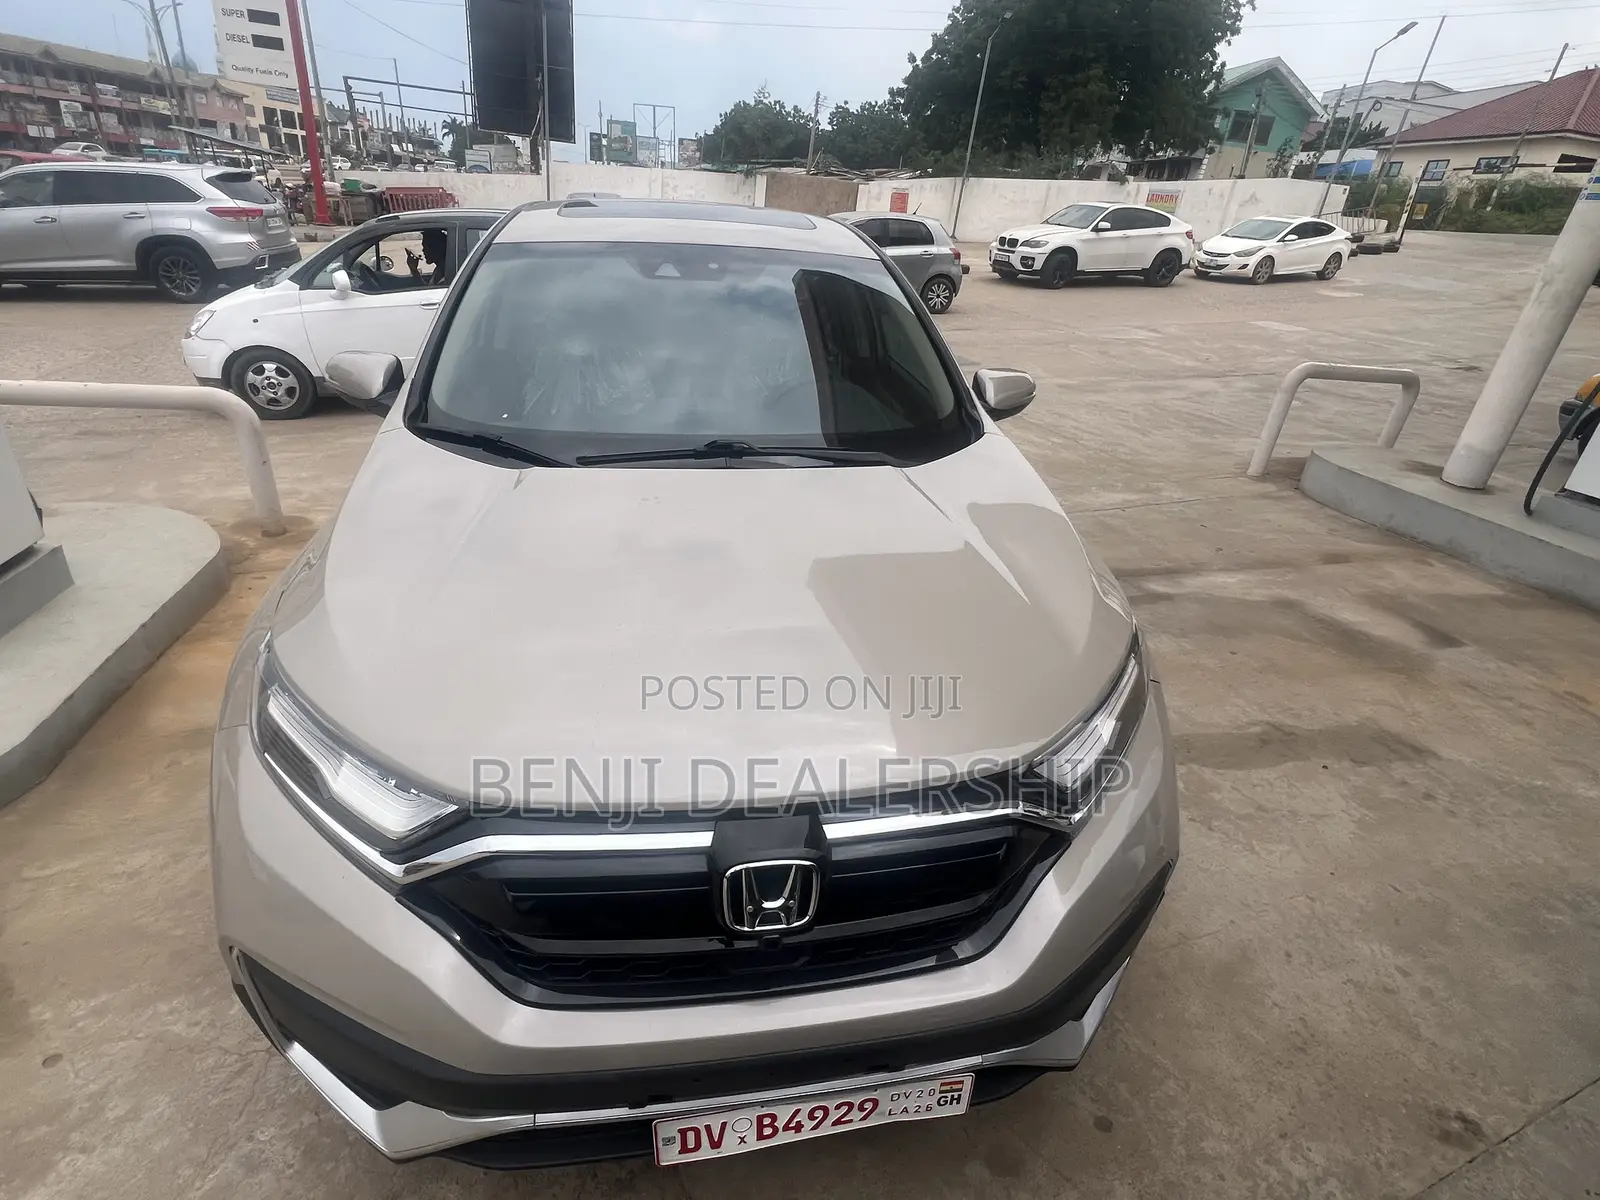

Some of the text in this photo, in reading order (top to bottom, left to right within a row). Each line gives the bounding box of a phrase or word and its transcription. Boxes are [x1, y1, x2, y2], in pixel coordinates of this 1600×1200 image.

[221, 8, 246, 19] SUPER
[226, 33, 251, 44] DIESEL
[232, 65, 289, 79] Quality Fuels Only
[1146, 192, 1179, 204] LAUNDRY
[937, 1093, 962, 1107] GH
[677, 1097, 880, 1155] DV B4929
